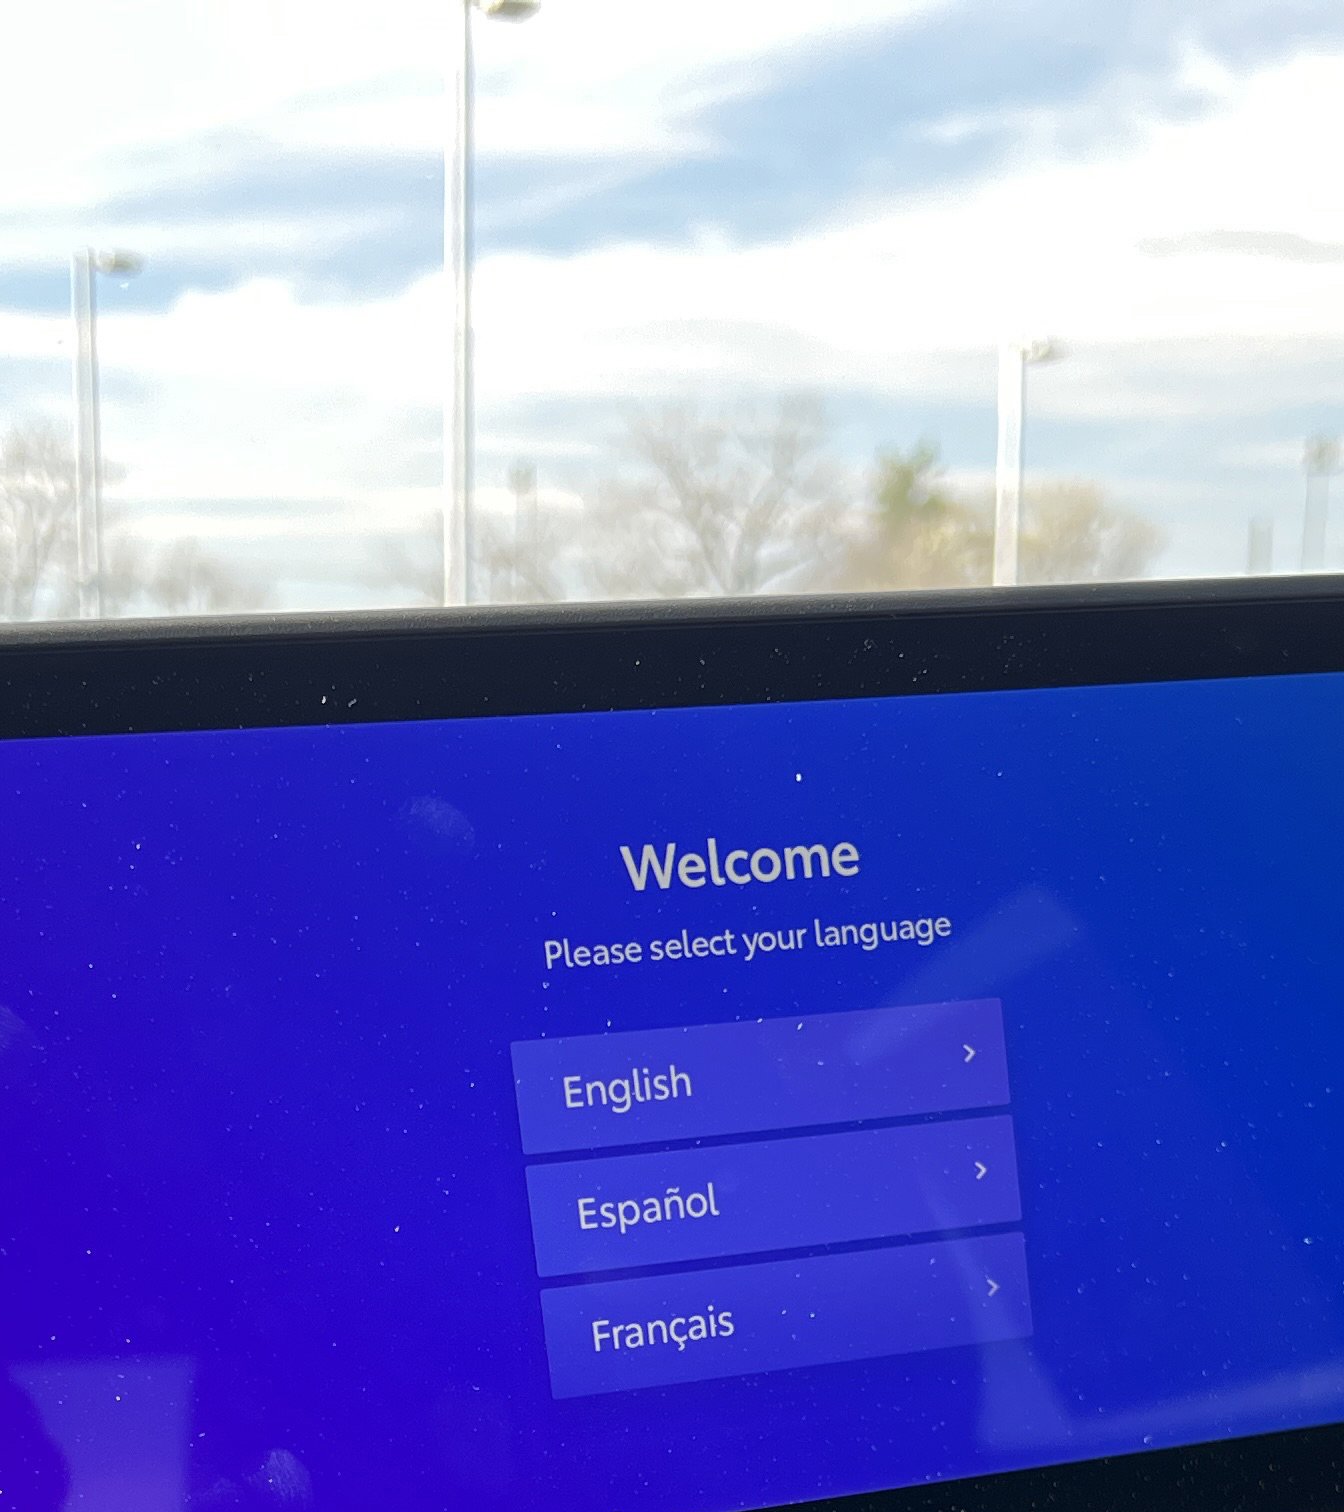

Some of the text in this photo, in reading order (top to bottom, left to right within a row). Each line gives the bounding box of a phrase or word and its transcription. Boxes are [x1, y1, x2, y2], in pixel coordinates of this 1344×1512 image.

[620, 837, 861, 891] Welcome
[544, 915, 953, 969] Please select your language
[563, 1066, 693, 1112] English
[577, 1183, 720, 1233] Español
[591, 1306, 734, 1352] Français
